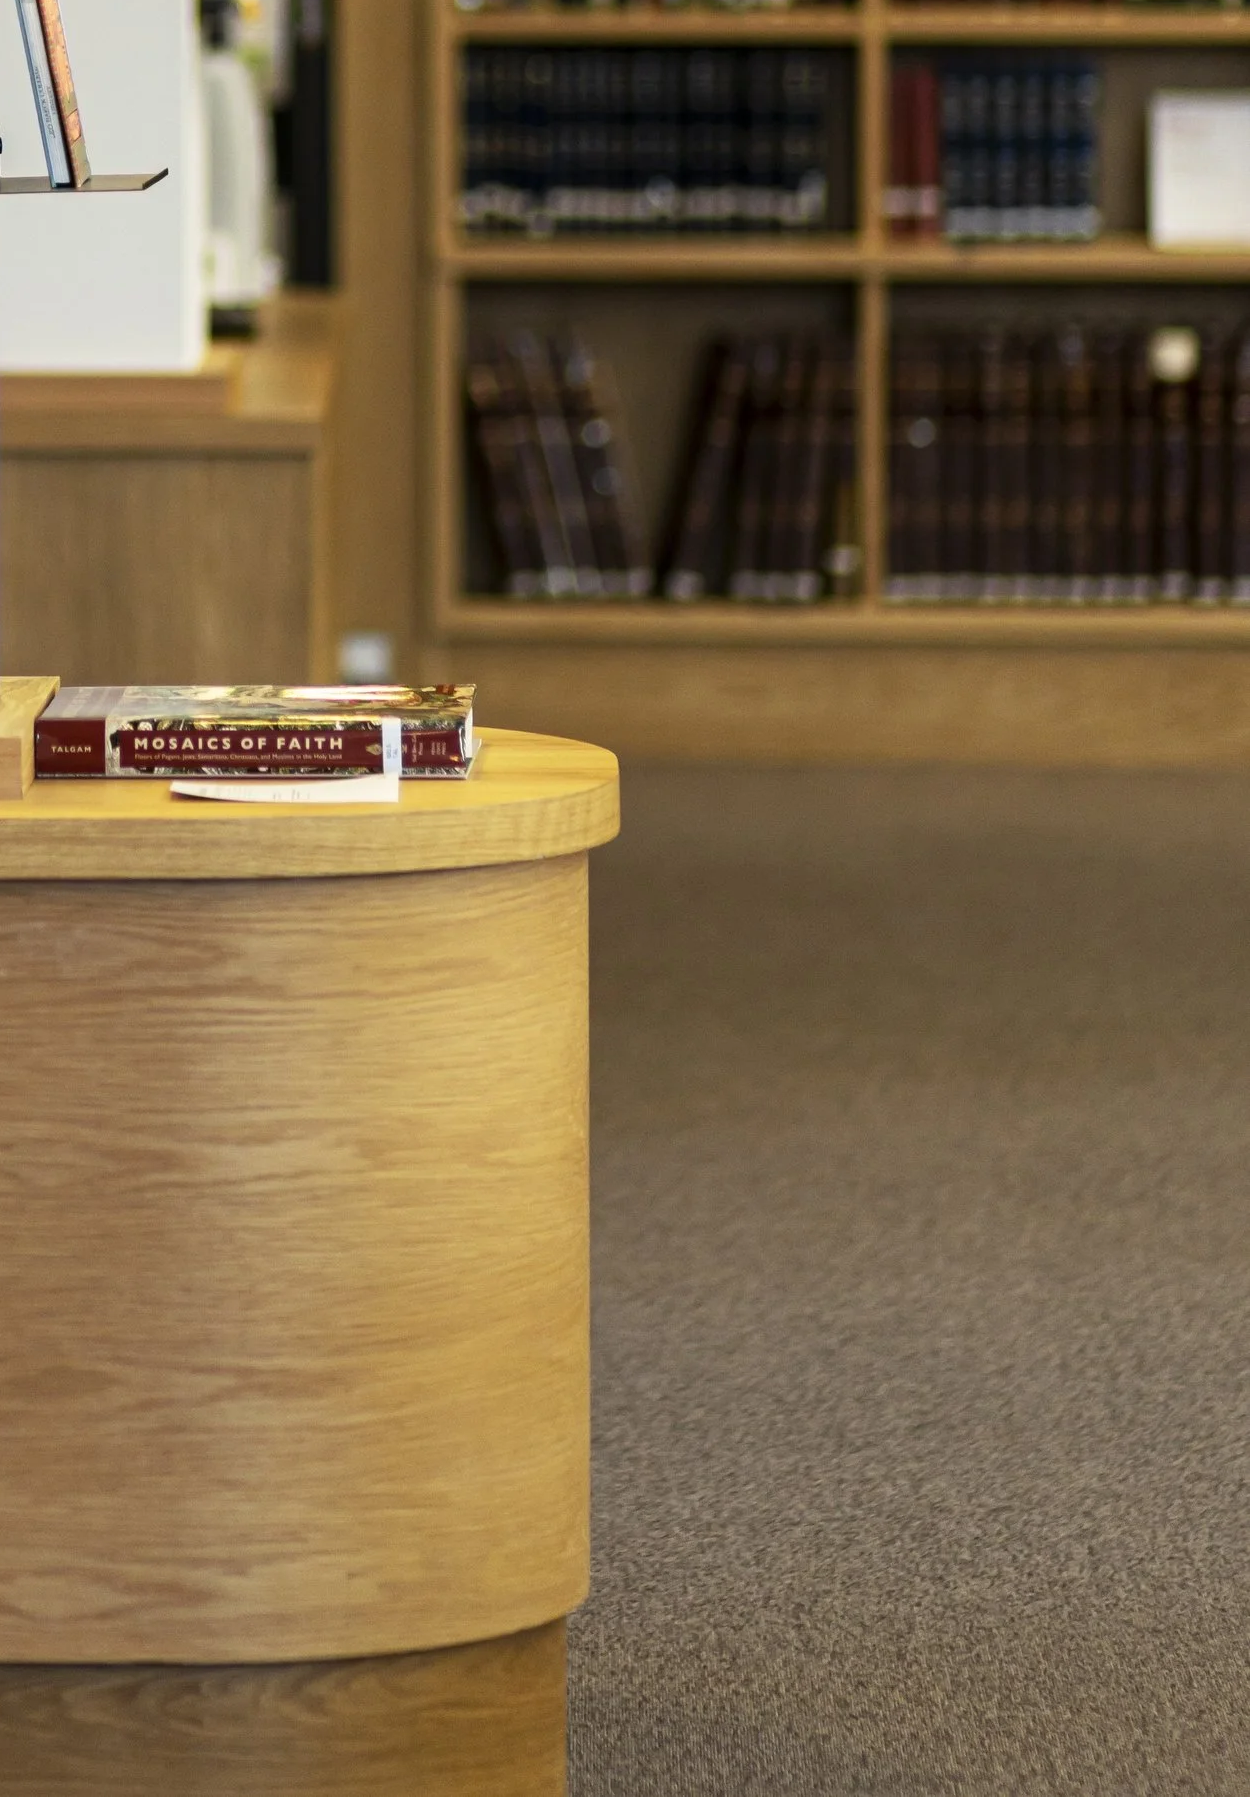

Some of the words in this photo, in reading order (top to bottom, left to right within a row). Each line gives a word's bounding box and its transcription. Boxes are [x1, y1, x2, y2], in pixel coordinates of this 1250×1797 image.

[134, 737, 231, 750] MOSAICS
[240, 737, 267, 750] OF
[276, 737, 343, 750] FAITH
[314, 753, 327, 761] Holy
